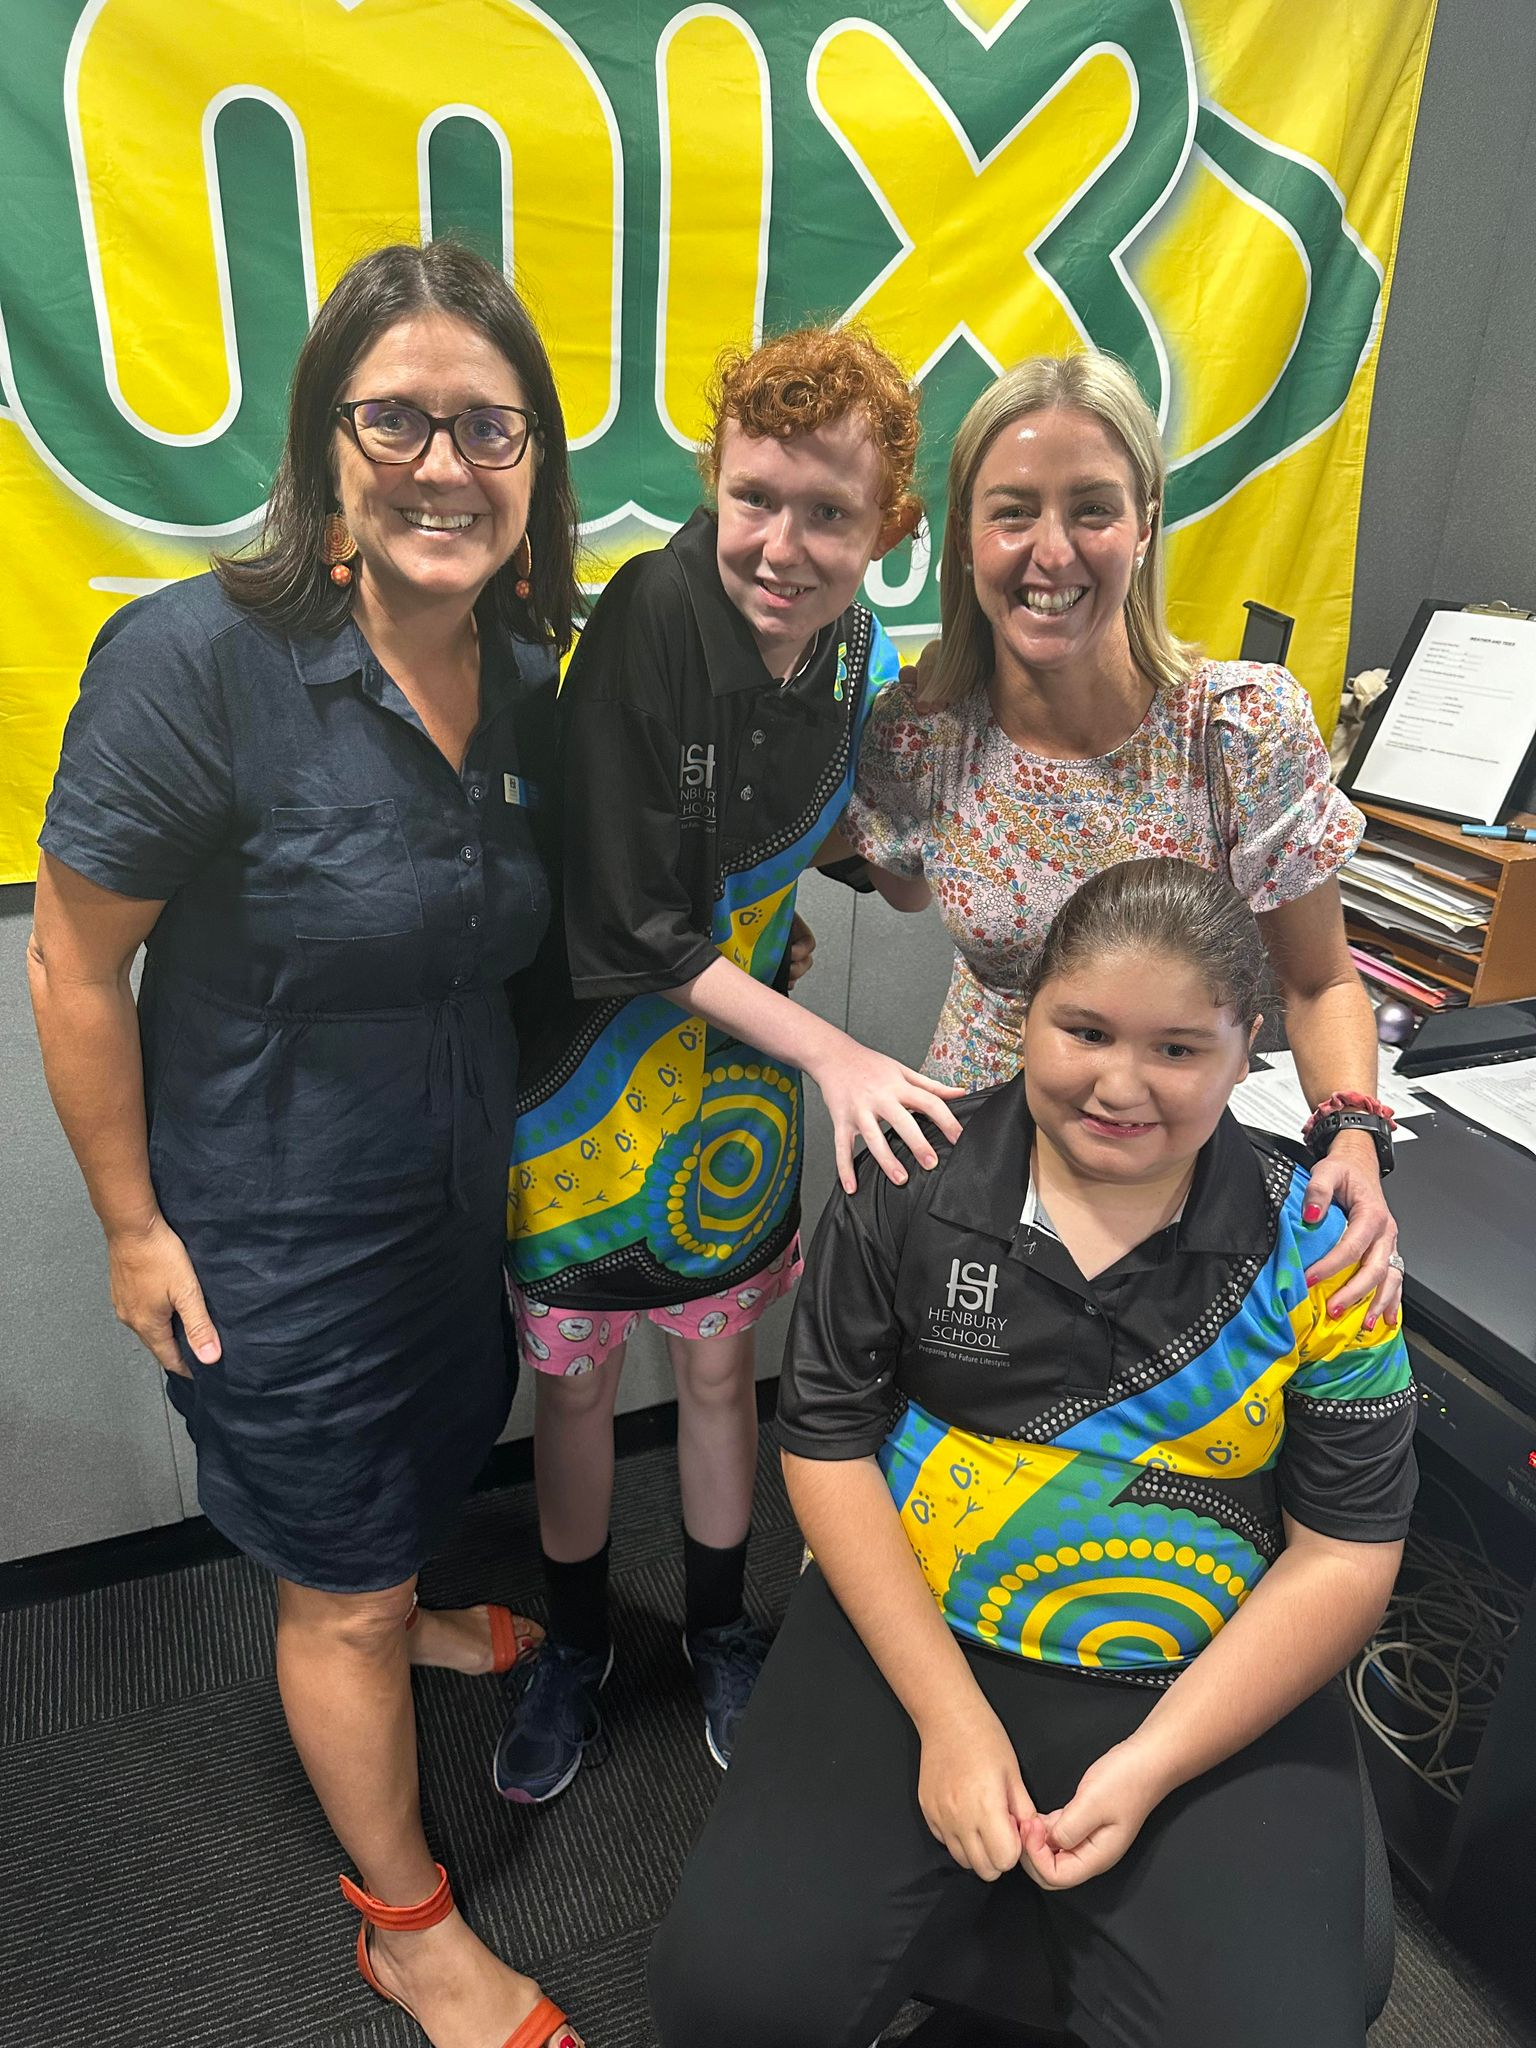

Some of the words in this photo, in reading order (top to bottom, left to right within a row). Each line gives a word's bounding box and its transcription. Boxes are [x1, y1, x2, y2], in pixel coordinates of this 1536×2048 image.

[928, 1307, 1008, 1331] HENBURY
[931, 1325, 1001, 1349] SCHOOL
[918, 1343, 948, 1358] Preparing
[948, 1351, 957, 1360] for
[958, 1353, 979, 1364] Future
[979, 1357, 1011, 1368] Lifestyles
